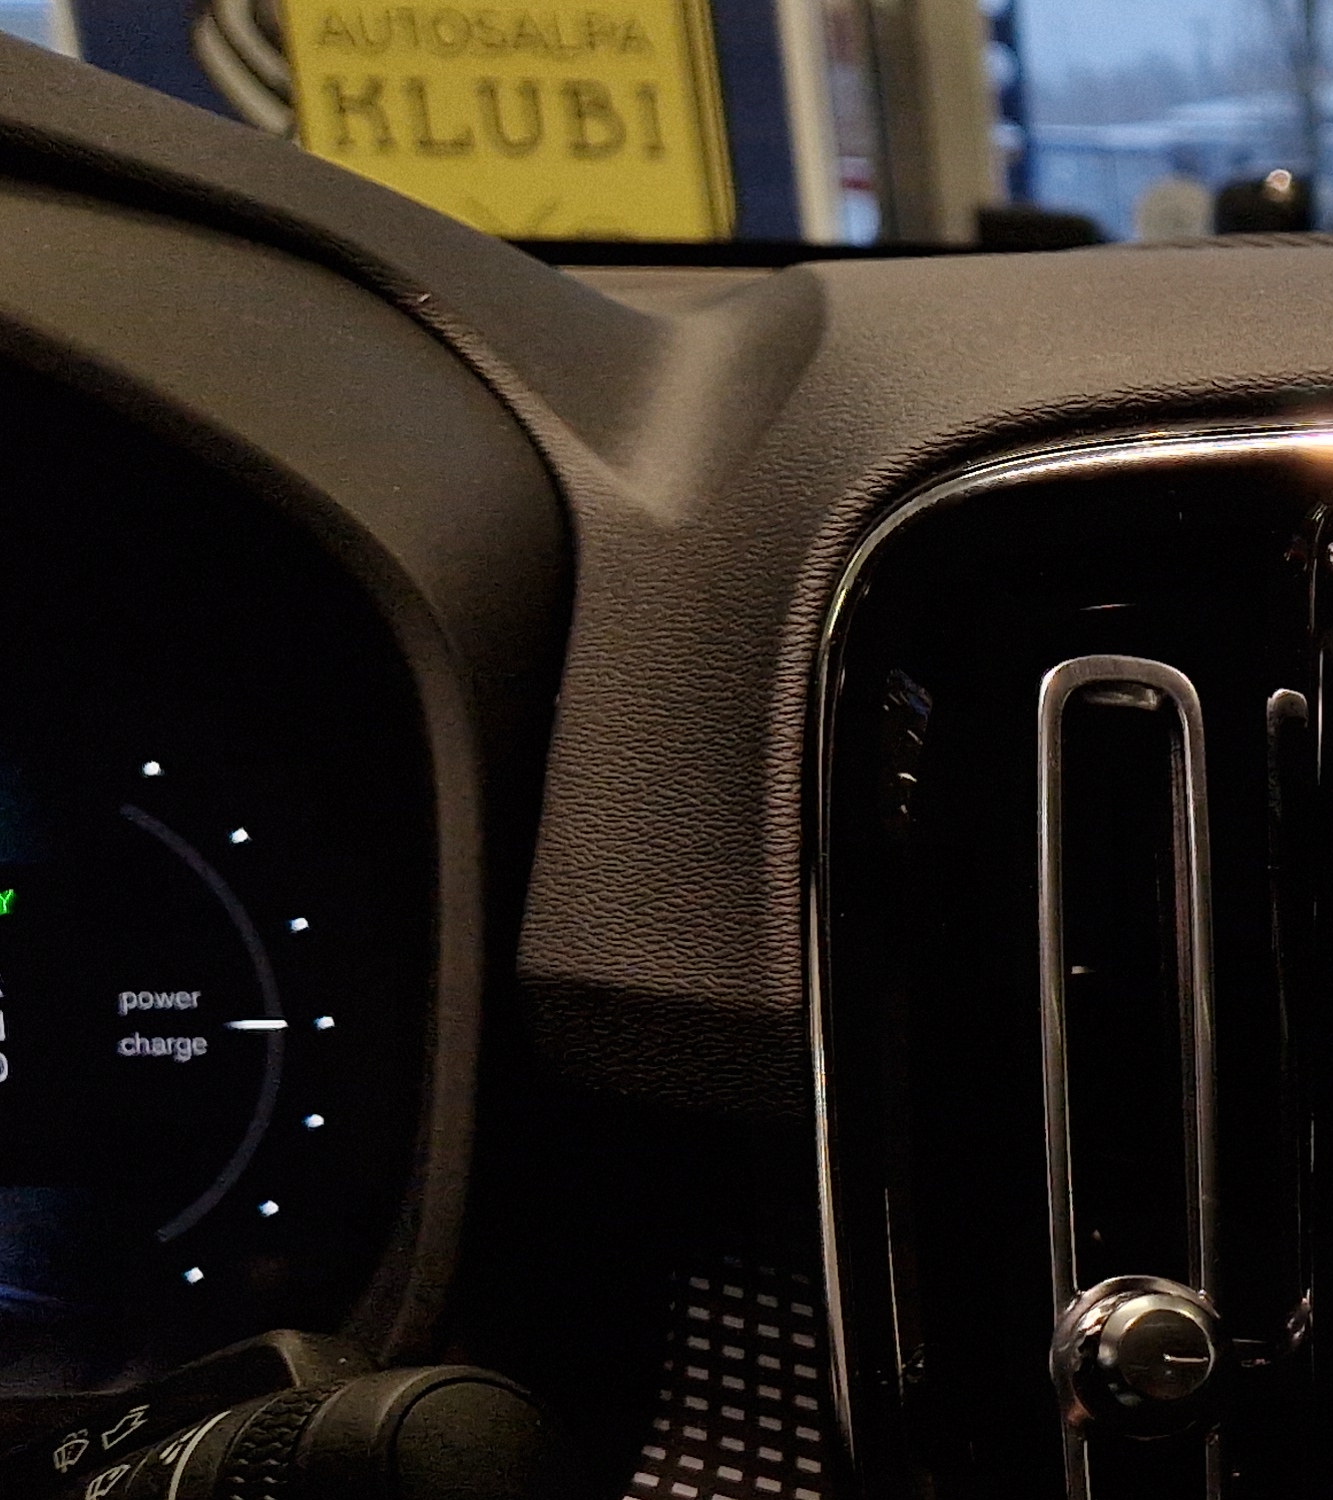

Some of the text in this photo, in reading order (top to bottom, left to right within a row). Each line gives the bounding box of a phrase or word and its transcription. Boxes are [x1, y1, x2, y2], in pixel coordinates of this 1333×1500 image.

[314, 6, 655, 61] AUTOSALPA
[321, 75, 667, 160] KLUBI
[118, 990, 201, 1016] power
[117, 1031, 209, 1064] charge
